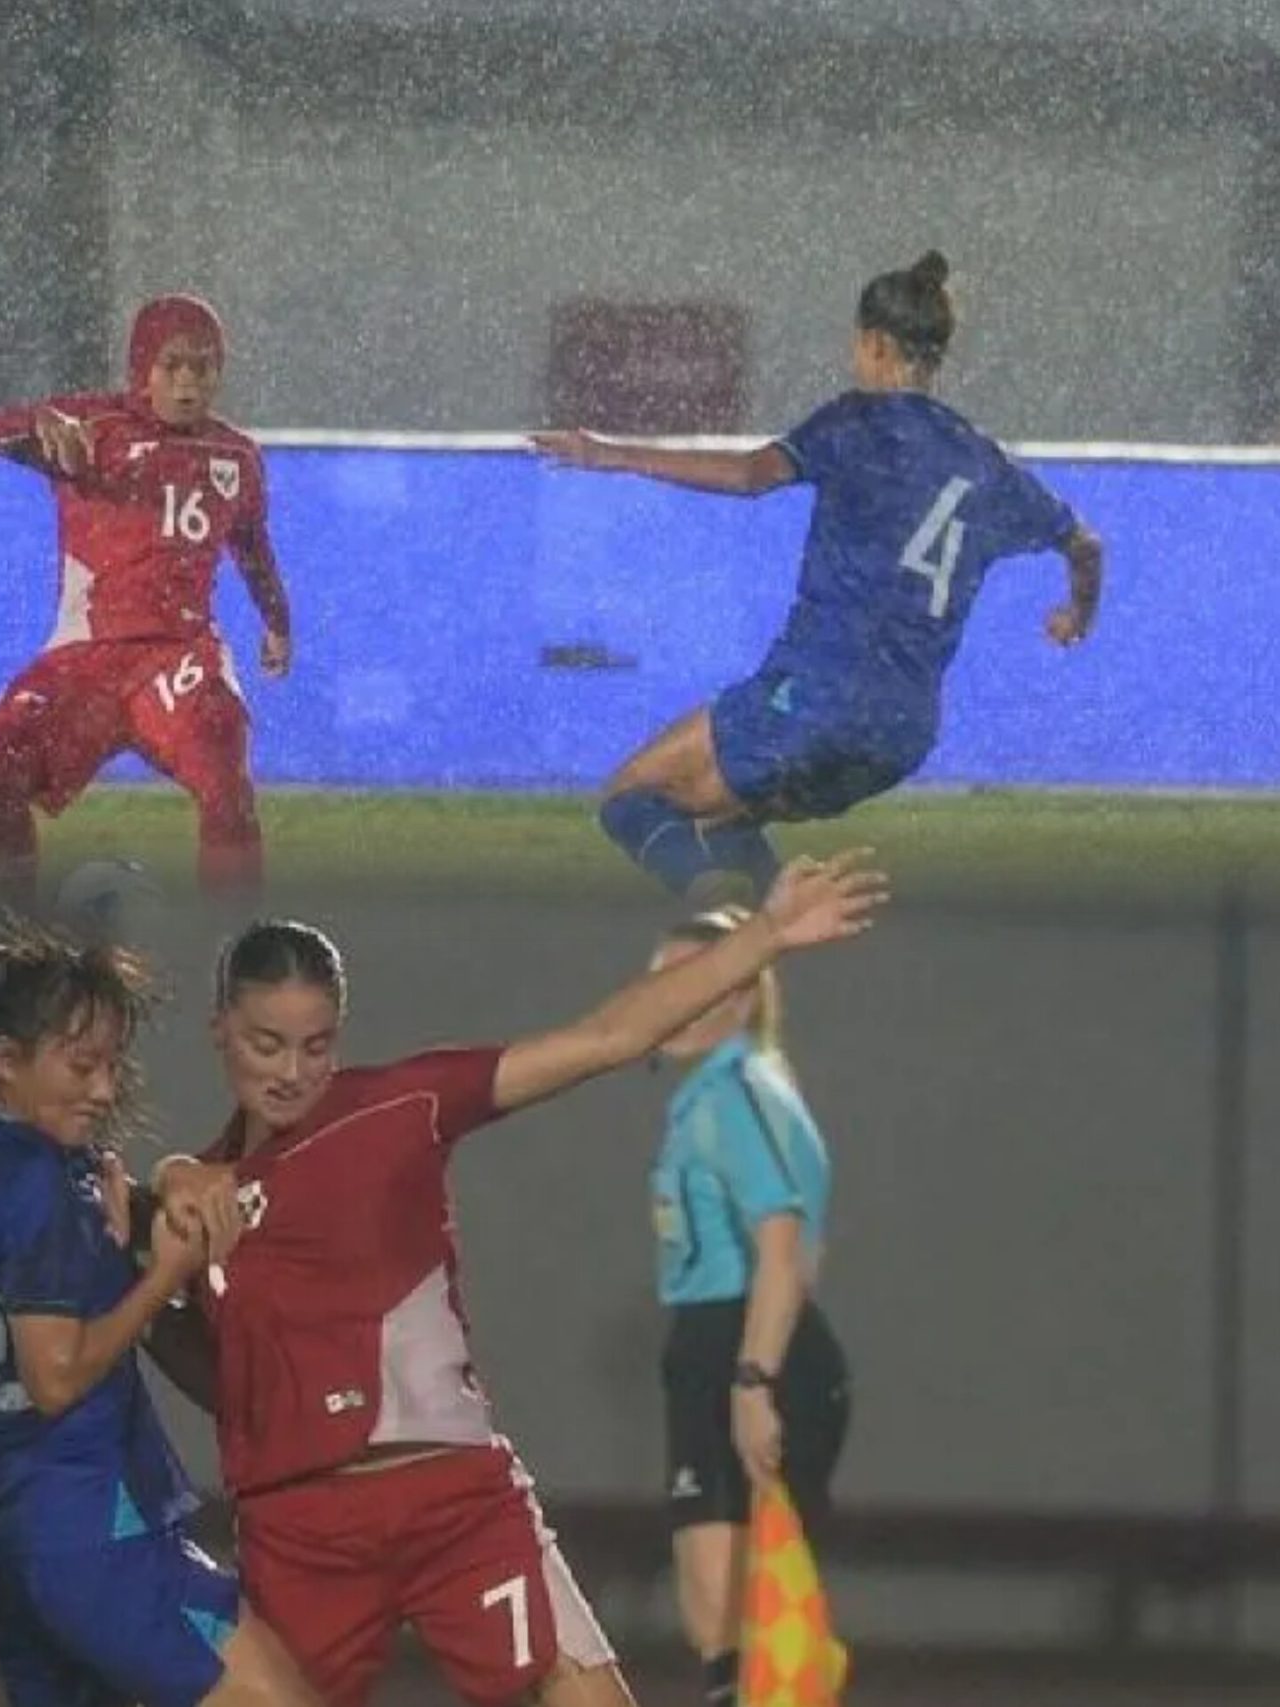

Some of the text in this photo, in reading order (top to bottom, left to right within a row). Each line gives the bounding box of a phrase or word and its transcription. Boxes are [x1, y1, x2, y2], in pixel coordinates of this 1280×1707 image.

[161, 485, 210, 542] 16
[899, 476, 973, 618] 4
[154, 653, 204, 713] 16
[480, 1575, 534, 1668] 7
